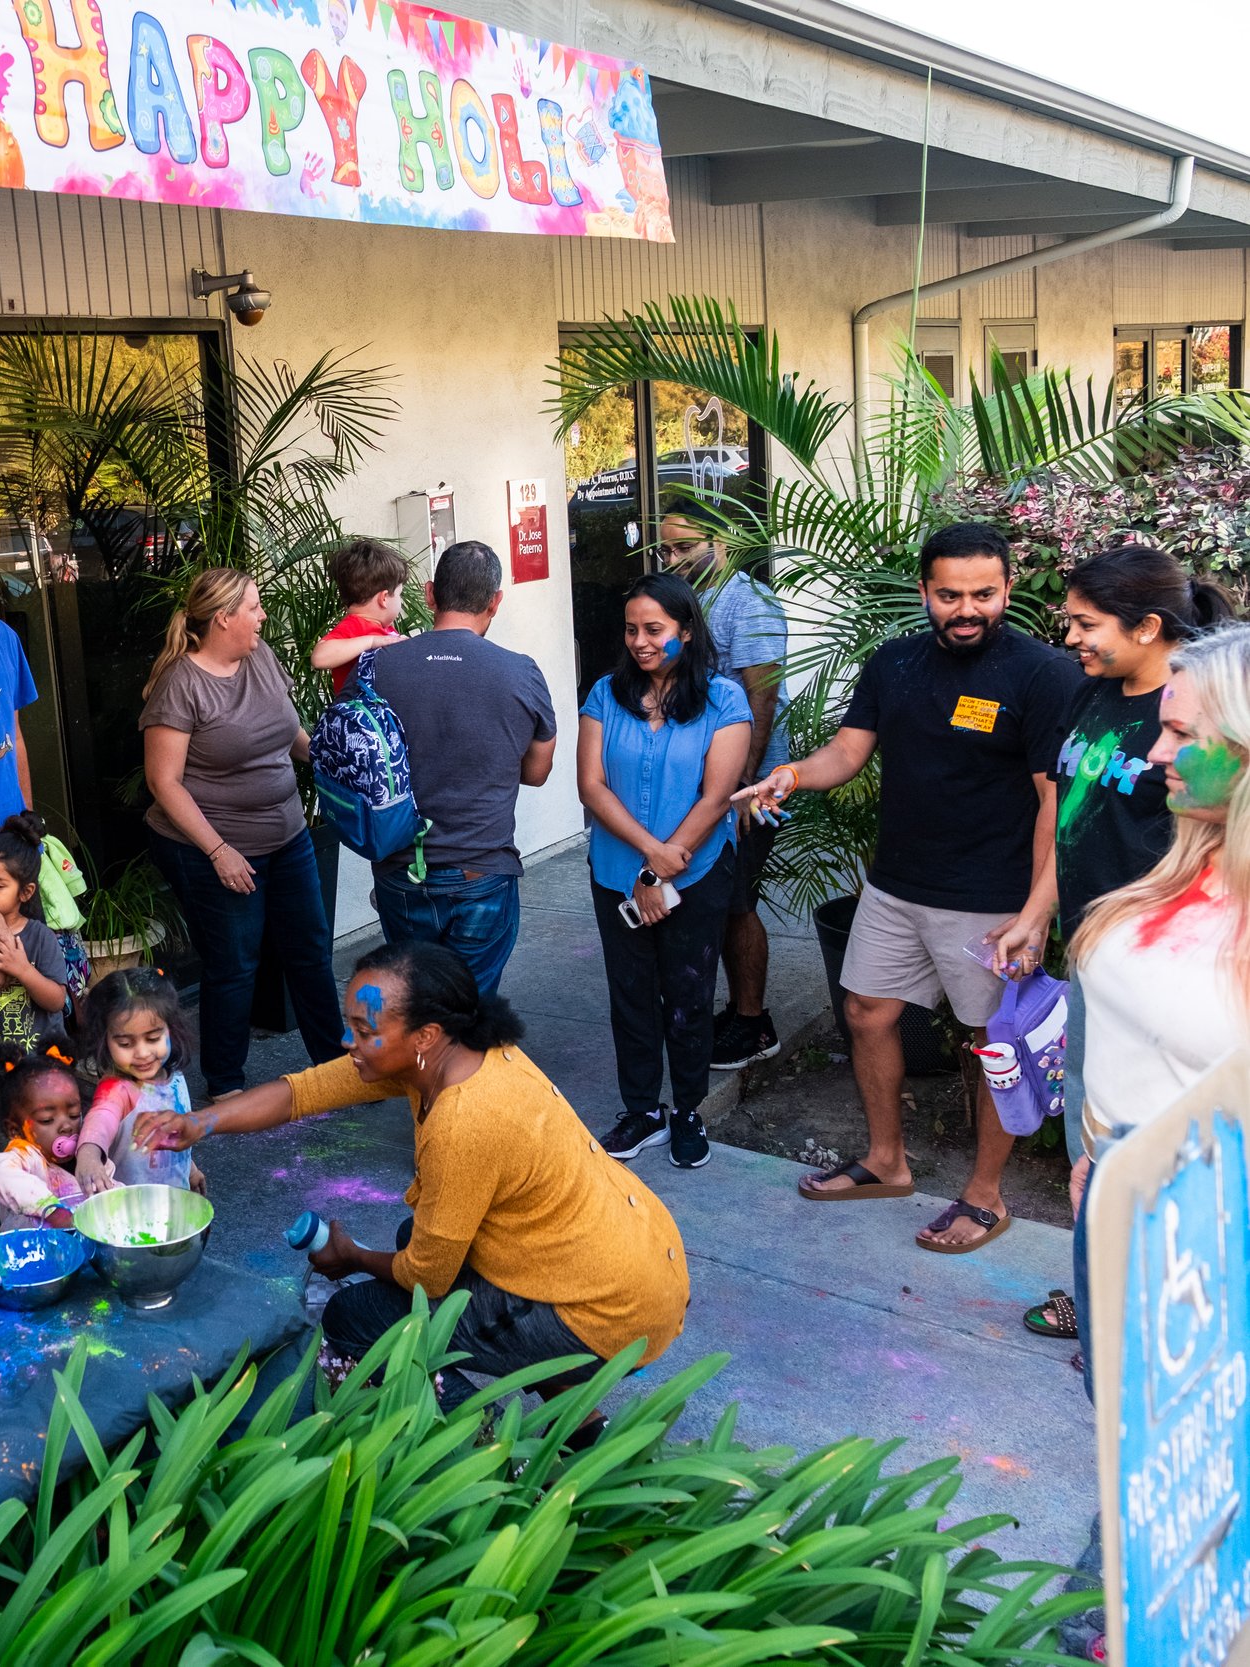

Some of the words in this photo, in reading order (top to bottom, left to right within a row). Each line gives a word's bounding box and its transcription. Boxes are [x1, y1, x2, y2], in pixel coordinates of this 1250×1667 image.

[17, 0, 366, 187] HAPPY
[387, 69, 584, 207] HOLI
[520, 483, 537, 502] 129
[577, 490, 584, 501] By
[617, 484, 629, 496] Only
[518, 530, 528, 541] Dr.
[528, 530, 542, 541] Jose
[518, 543, 543, 555] Paterno
[1127, 1351, 1247, 1540] RESTRICTED
[1151, 1436, 1234, 1570] PARKING
